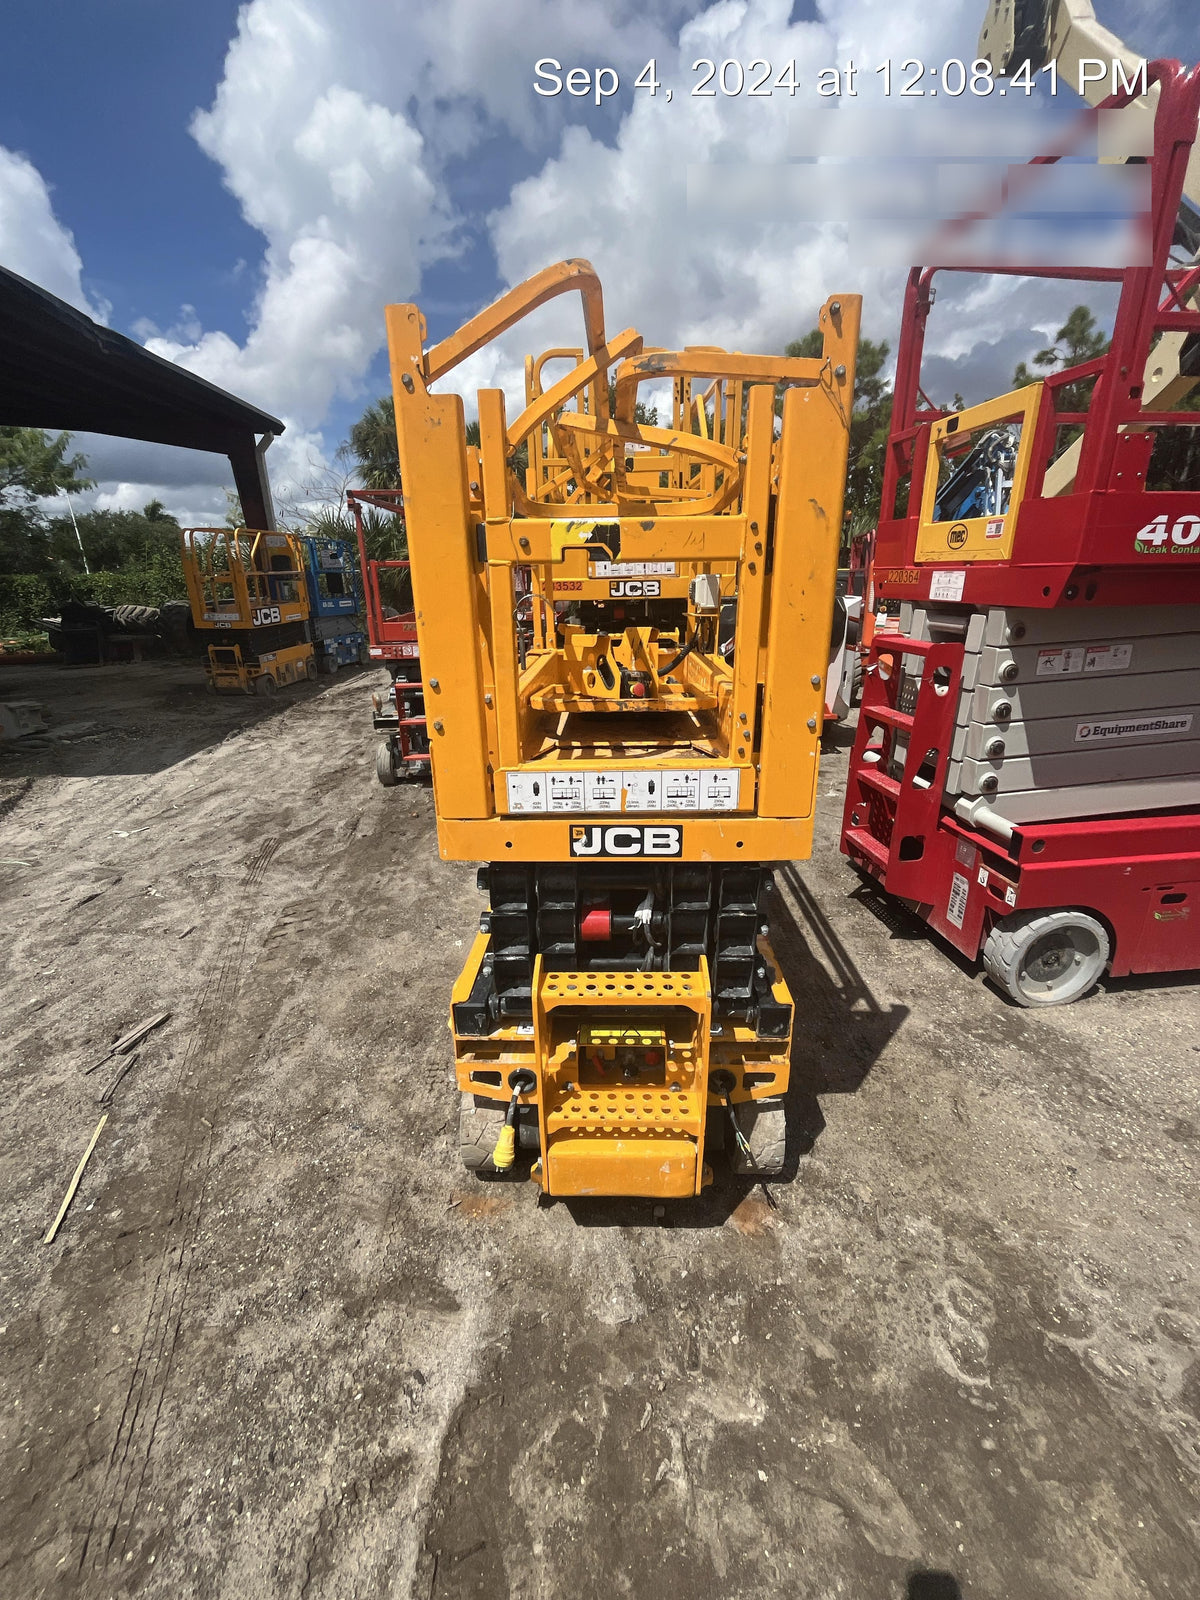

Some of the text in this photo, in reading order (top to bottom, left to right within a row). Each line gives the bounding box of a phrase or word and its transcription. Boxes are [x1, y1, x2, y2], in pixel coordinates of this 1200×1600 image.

[1143, 545, 1168, 554] Leak
[888, 570, 919, 583] 220364
[610, 581, 660, 596] JCB
[252, 607, 280, 626] JCB
[1092, 720, 1187, 736] EquipmentShare
[572, 826, 681, 855] JCB
